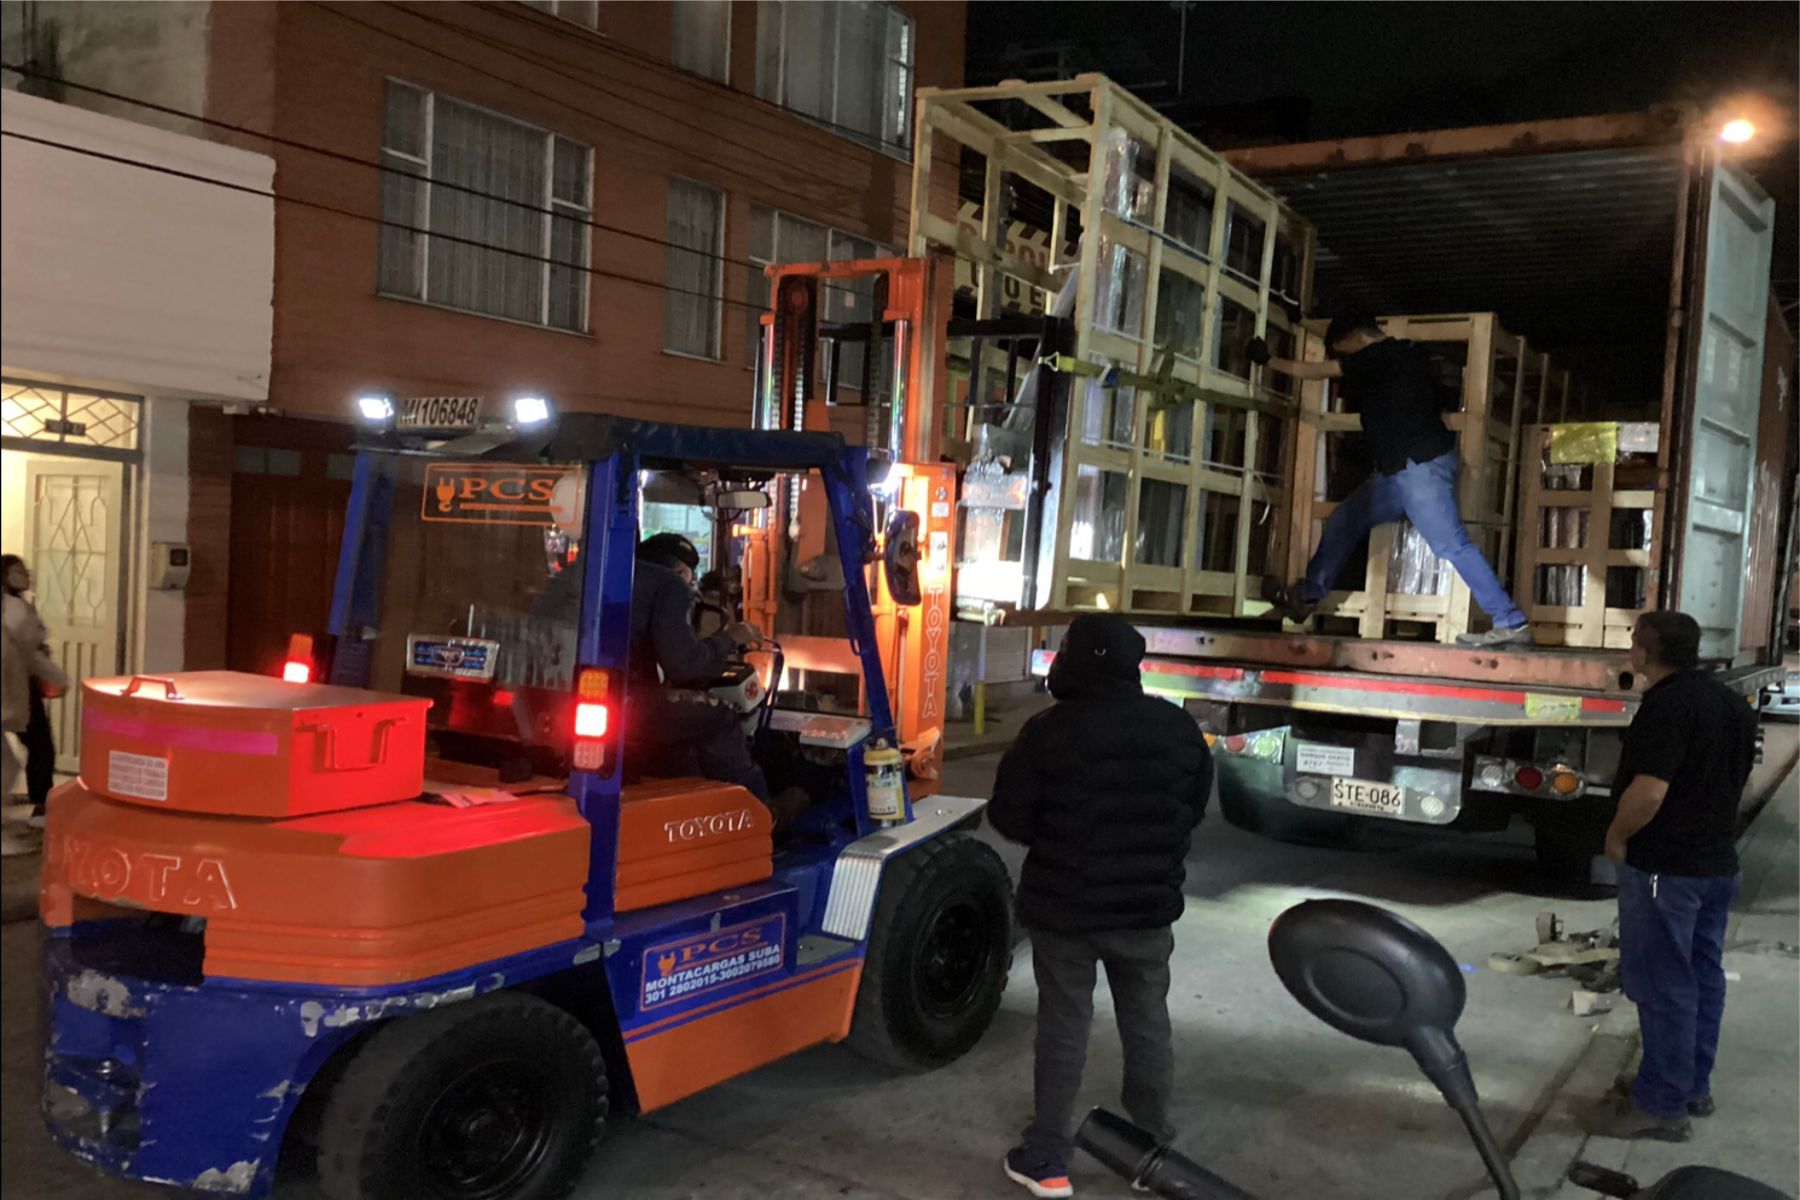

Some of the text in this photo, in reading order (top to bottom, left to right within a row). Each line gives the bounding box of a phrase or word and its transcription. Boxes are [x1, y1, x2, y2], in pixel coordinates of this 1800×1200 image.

[458, 477, 554, 501] PCS
[922, 583, 944, 719] TOYOTA
[1334, 783, 1401, 807] STE-086
[664, 808, 753, 843] TOYOTA
[680, 927, 761, 961] PCS
[645, 943, 780, 993] MONTACARGAS SUBA
[645, 988, 666, 1004] 301
